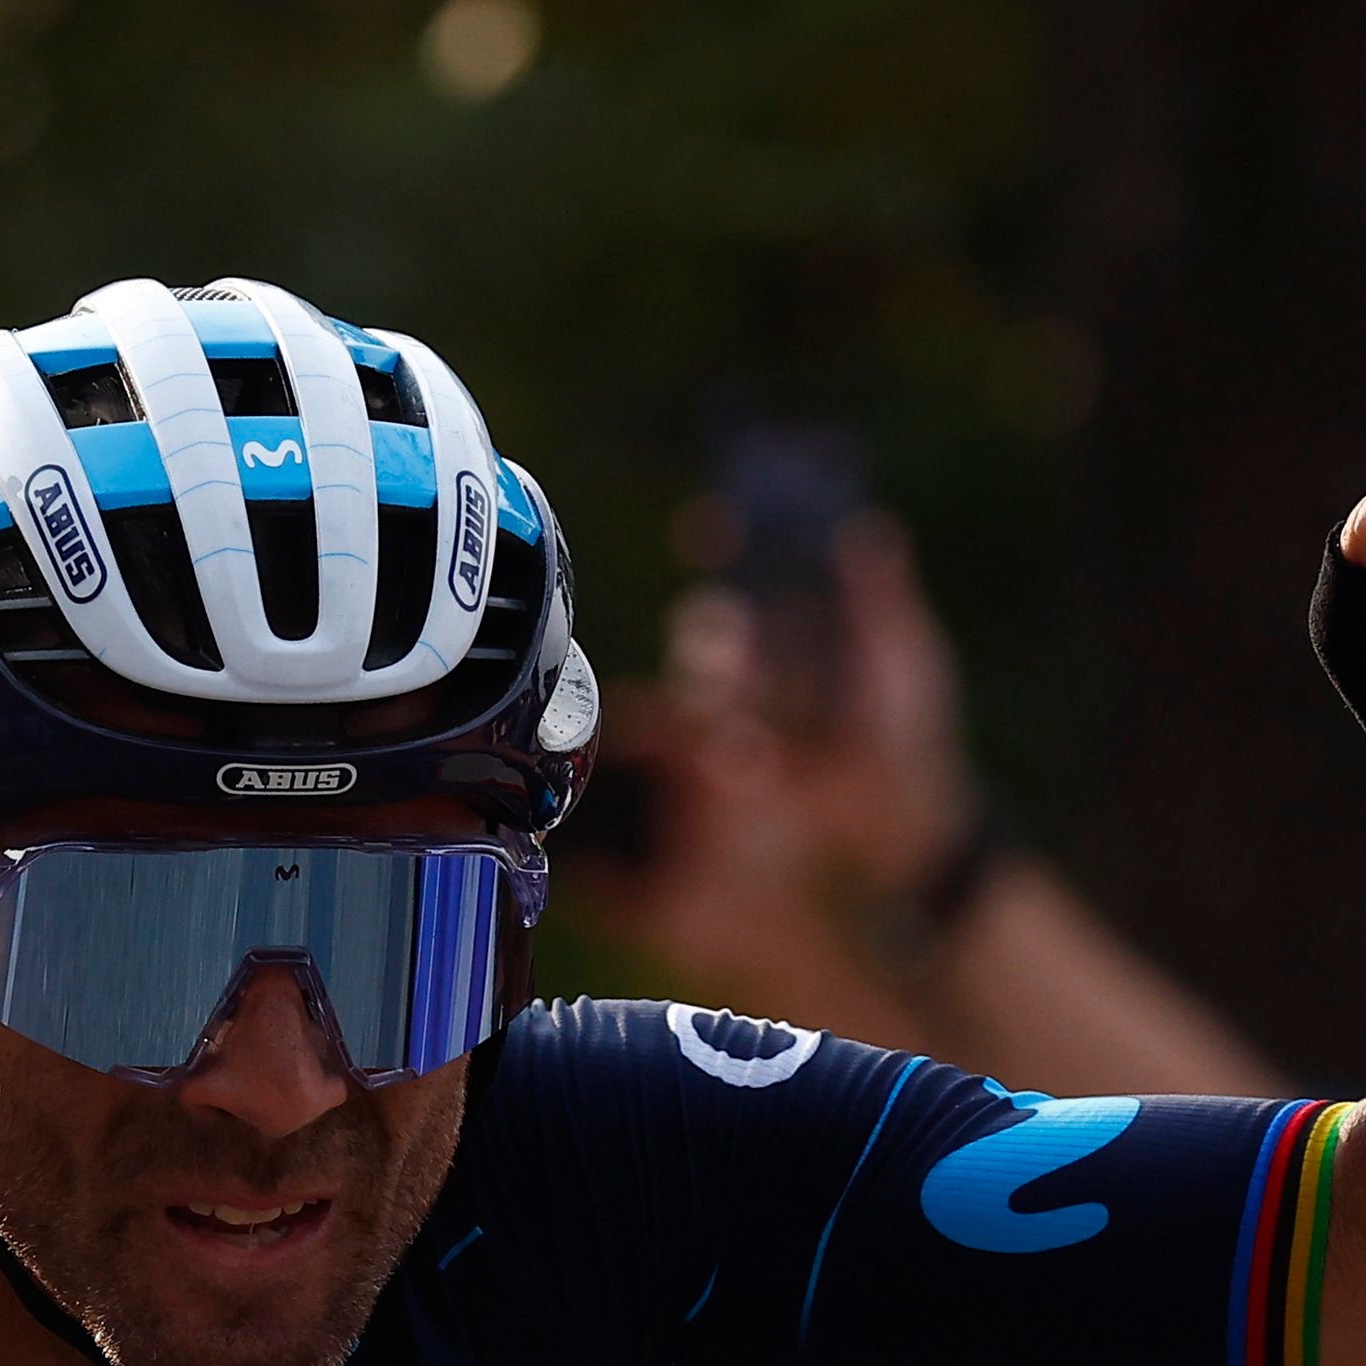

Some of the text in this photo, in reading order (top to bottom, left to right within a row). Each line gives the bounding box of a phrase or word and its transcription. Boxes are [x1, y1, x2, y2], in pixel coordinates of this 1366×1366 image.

[34, 482, 95, 587] ABUS
[459, 485, 485, 596] ABUS
[235, 770, 341, 790] ABUS
